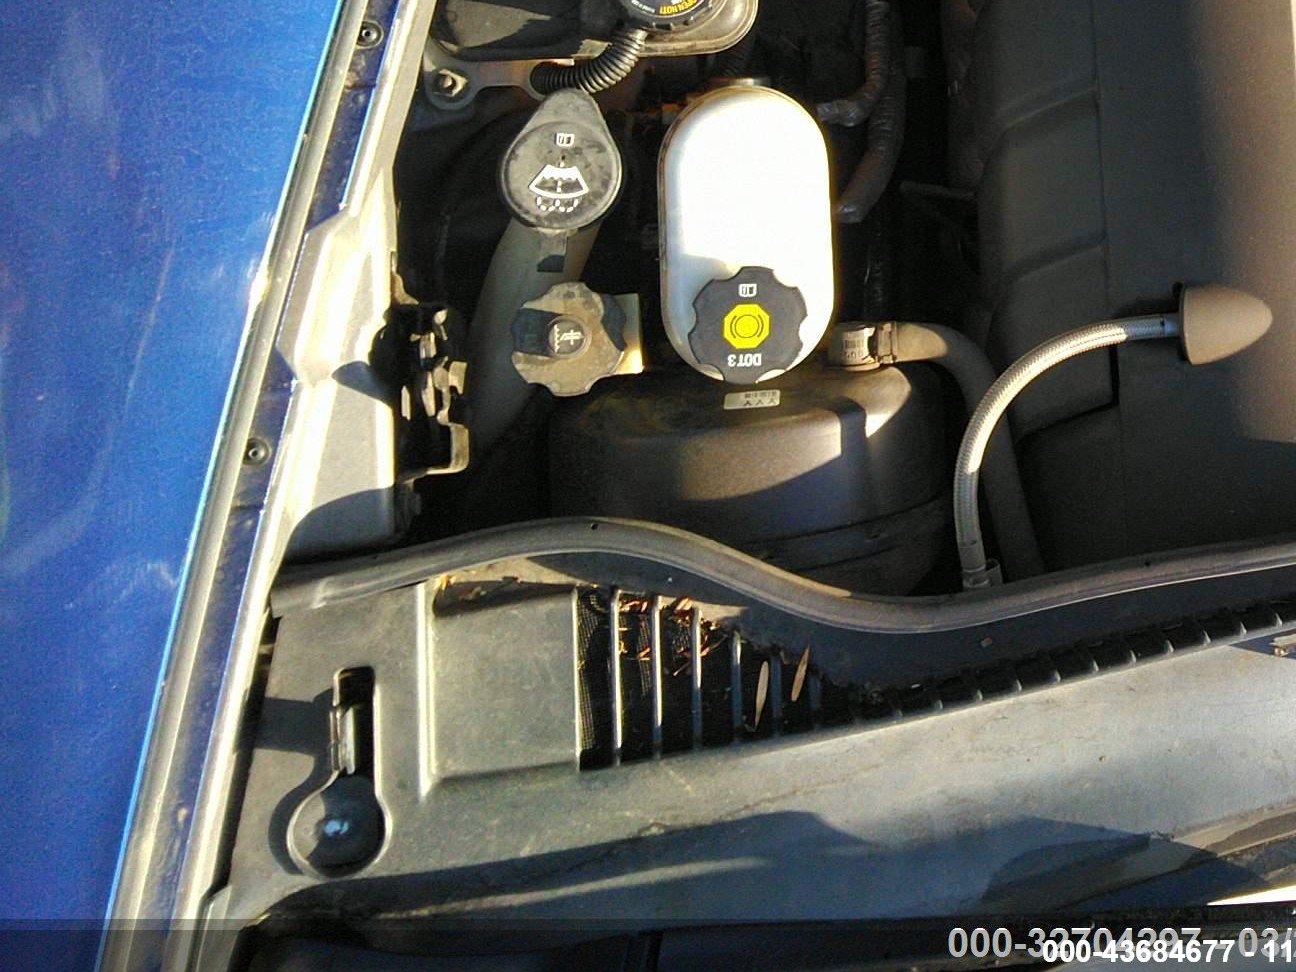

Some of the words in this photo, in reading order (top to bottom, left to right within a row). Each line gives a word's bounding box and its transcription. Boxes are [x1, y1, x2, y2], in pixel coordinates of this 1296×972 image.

[659, 5, 678, 15] HOT!
[727, 353, 737, 367] 3
[736, 353, 762, 367] DOT
